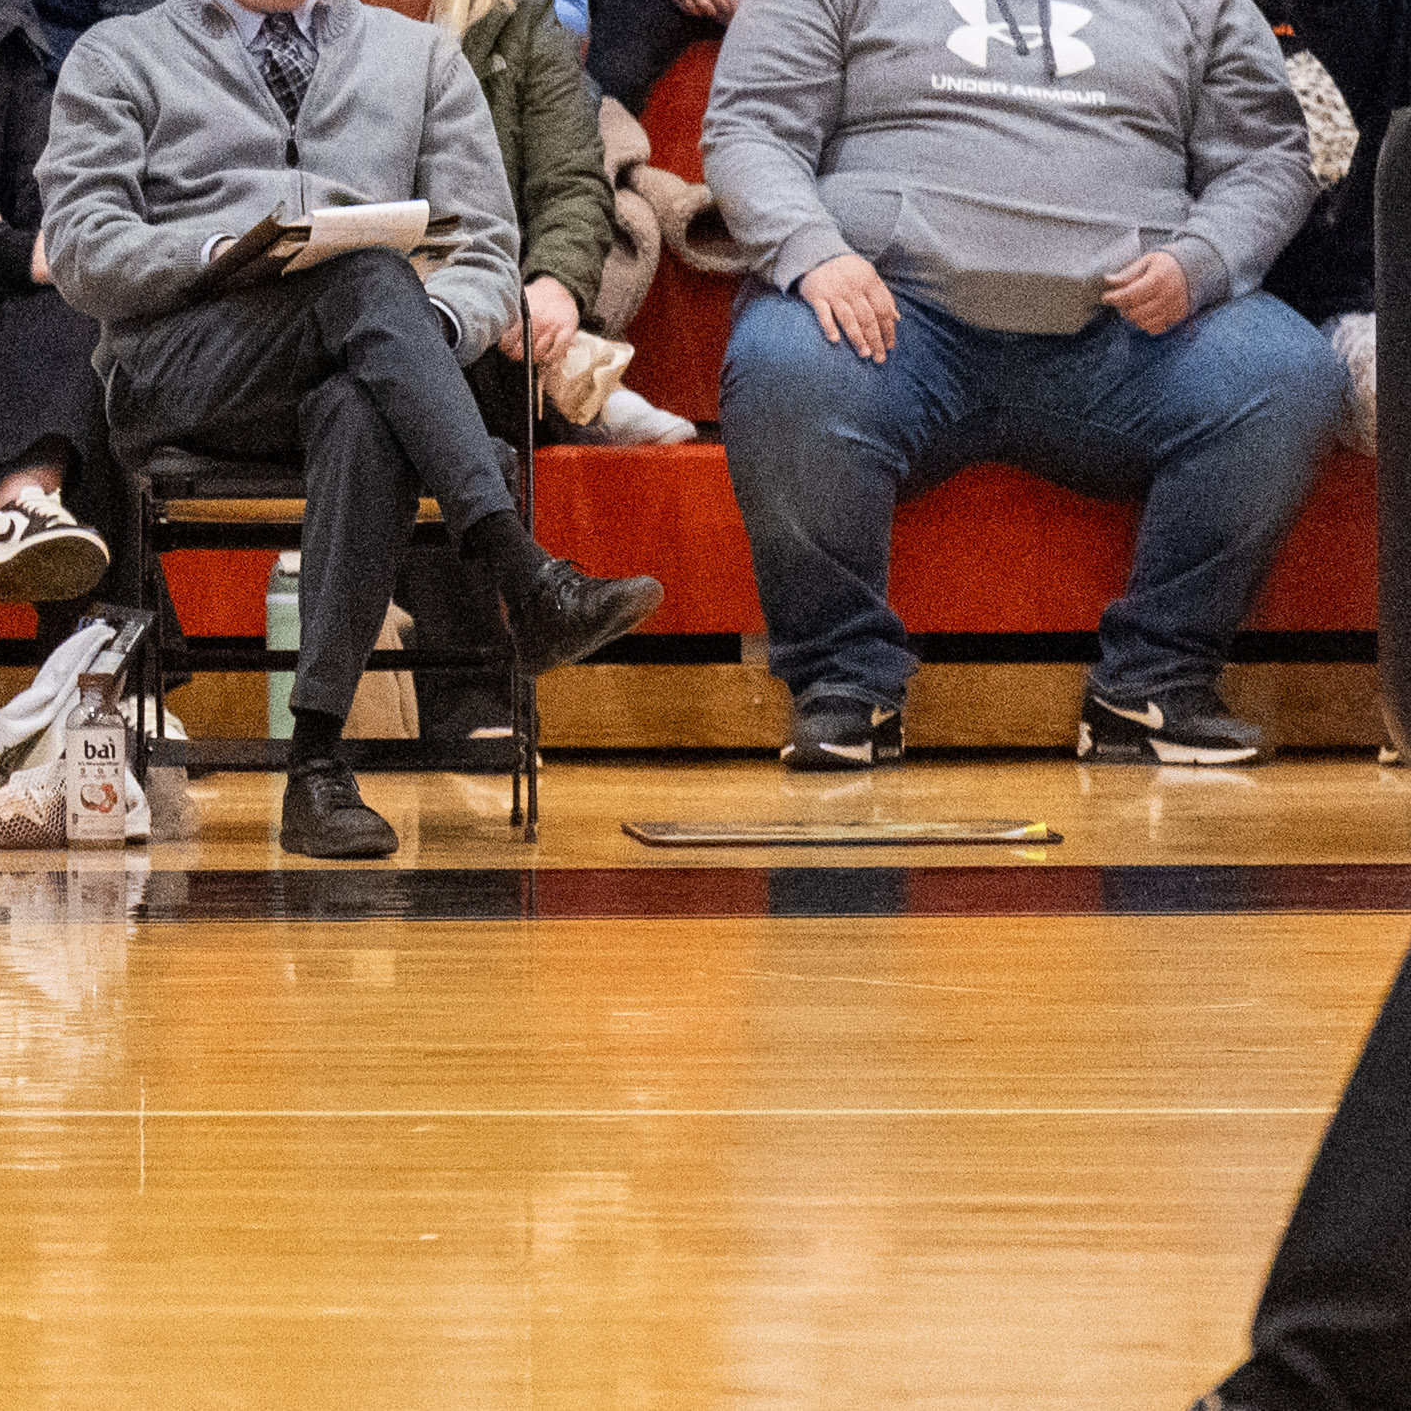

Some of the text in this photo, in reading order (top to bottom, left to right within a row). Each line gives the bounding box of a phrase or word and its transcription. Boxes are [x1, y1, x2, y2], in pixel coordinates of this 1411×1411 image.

[931, 72, 1107, 106] UNDER ARMOUR
[83, 736, 117, 761] bai
